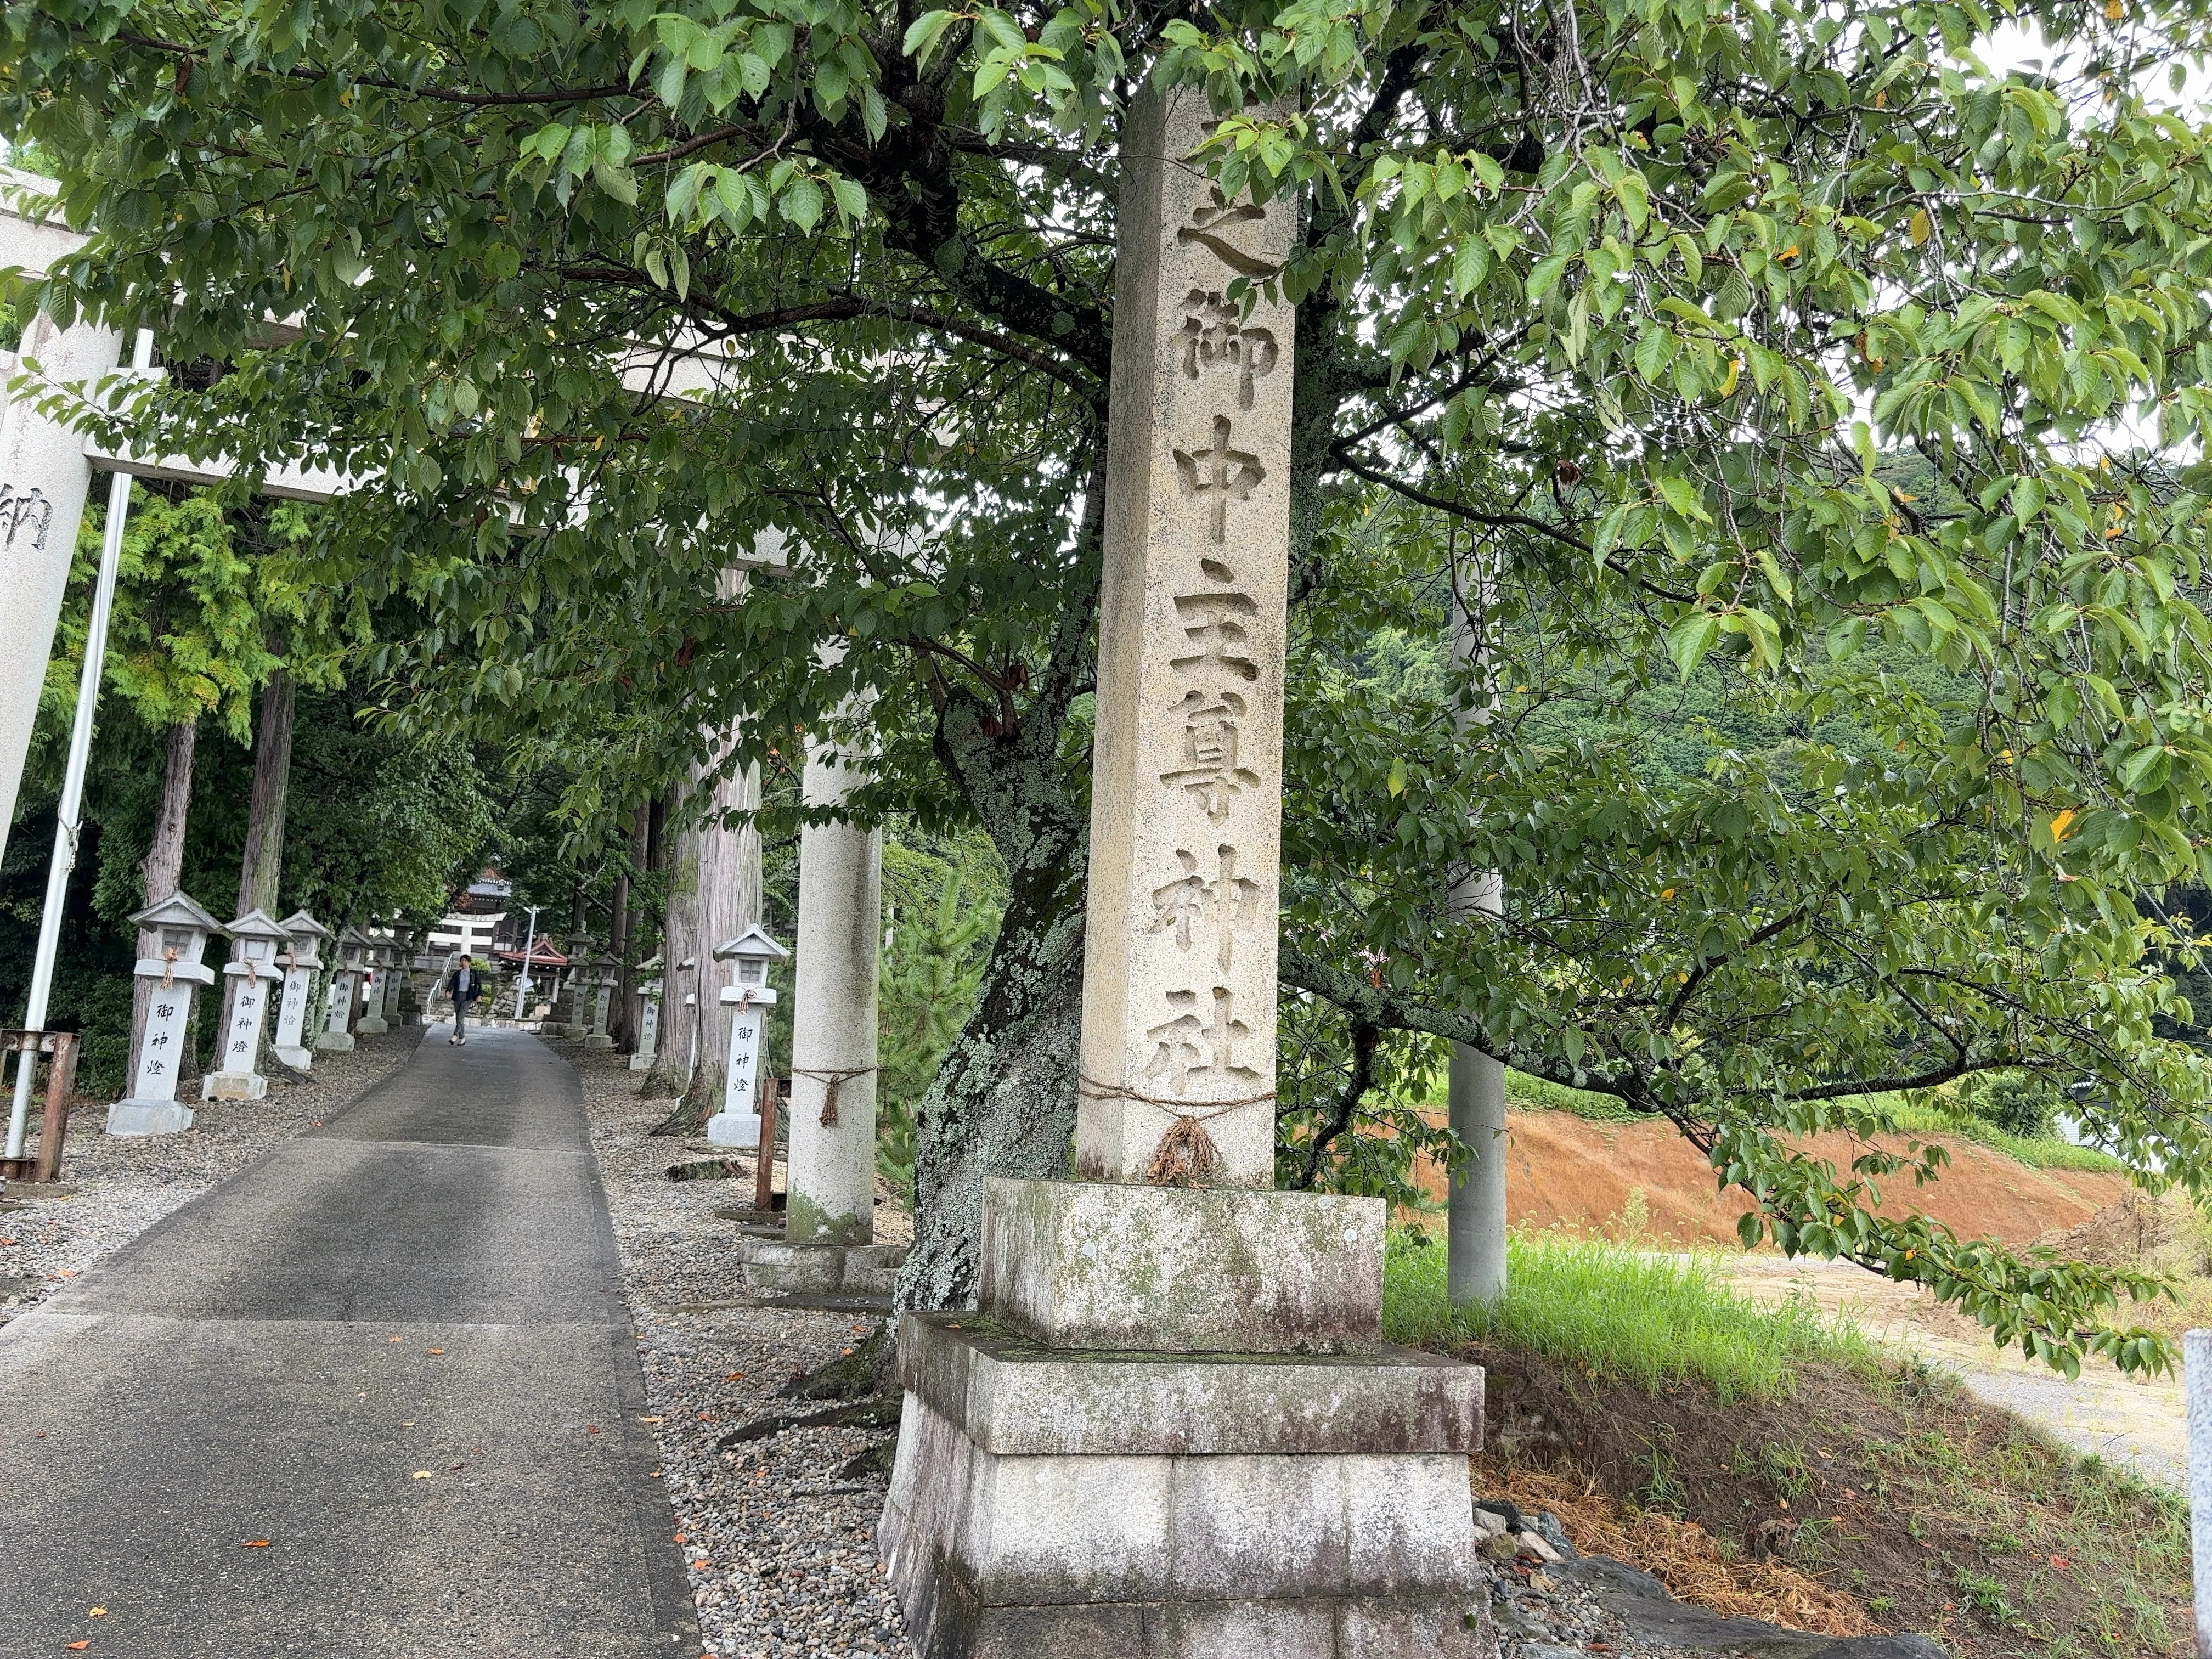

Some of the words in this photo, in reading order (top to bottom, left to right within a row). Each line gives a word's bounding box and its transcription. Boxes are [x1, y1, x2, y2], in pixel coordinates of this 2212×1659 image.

[232, 996, 255, 1053] 御神燈
[284, 980, 301, 1026] 御神燈
[146, 1004, 174, 1075] 御神燈
[734, 1027, 753, 1091] 御神燈
